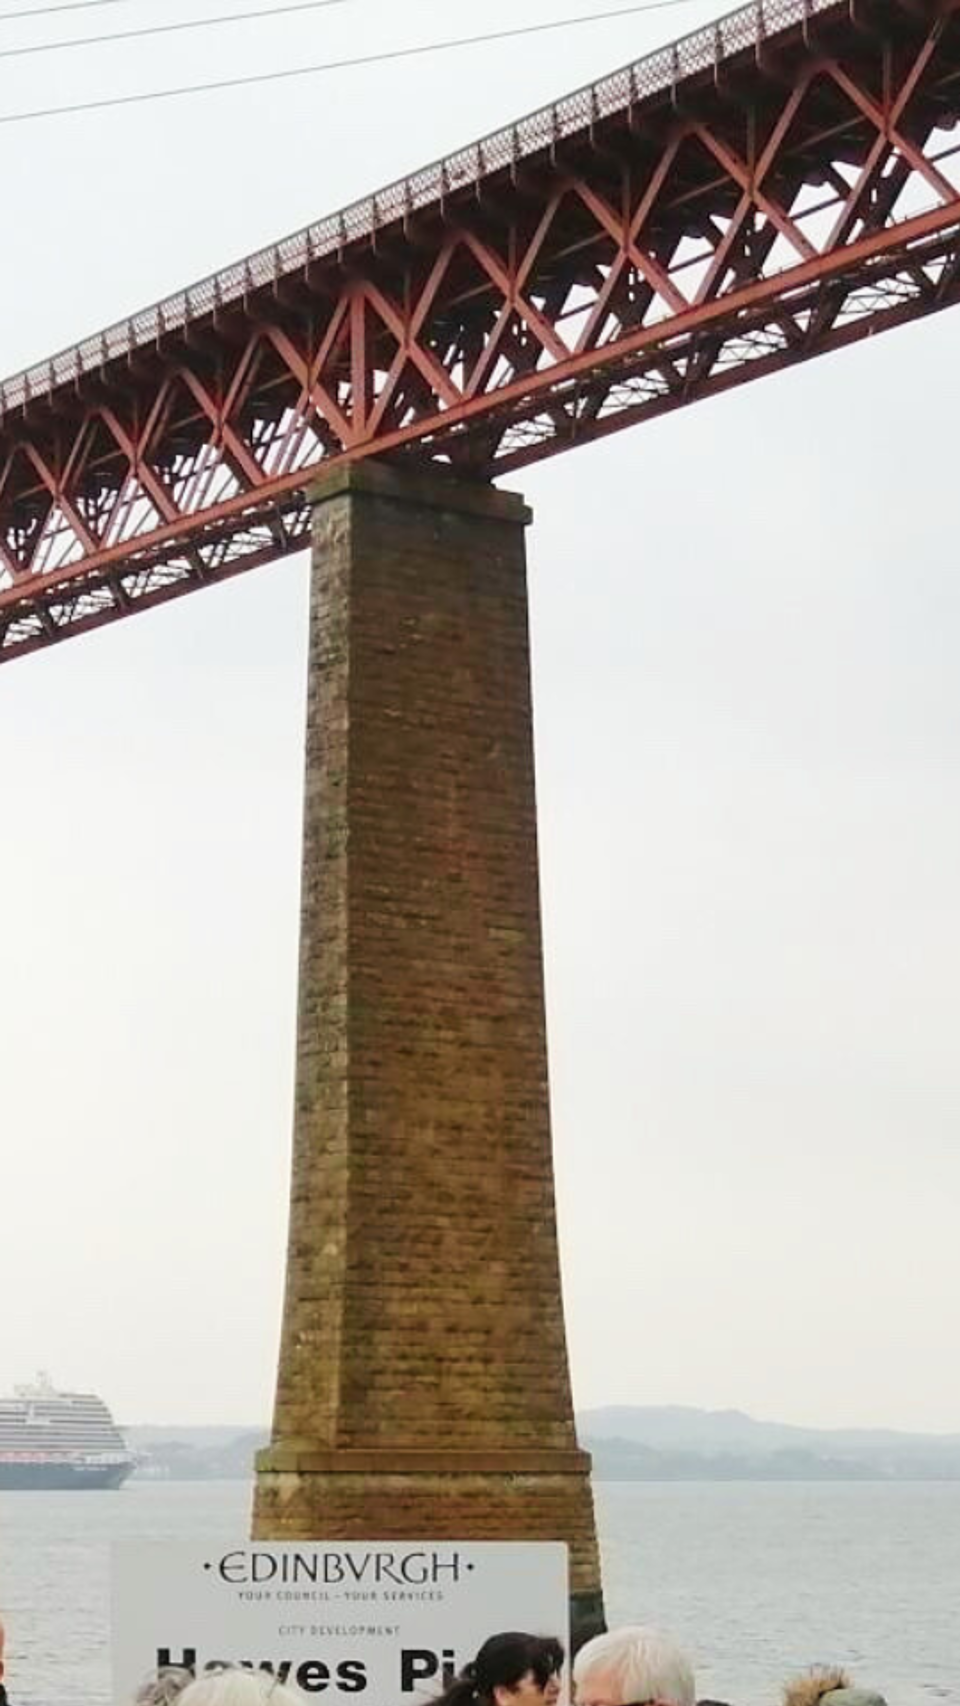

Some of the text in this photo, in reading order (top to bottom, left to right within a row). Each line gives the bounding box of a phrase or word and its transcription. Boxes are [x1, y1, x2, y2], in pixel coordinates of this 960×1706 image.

[238, 1591, 272, 1601] YOUR
[276, 1591, 330, 1601] COUNCIL
[344, 1591, 377, 1601] YOUR
[383, 1591, 444, 1601] SERVICES
